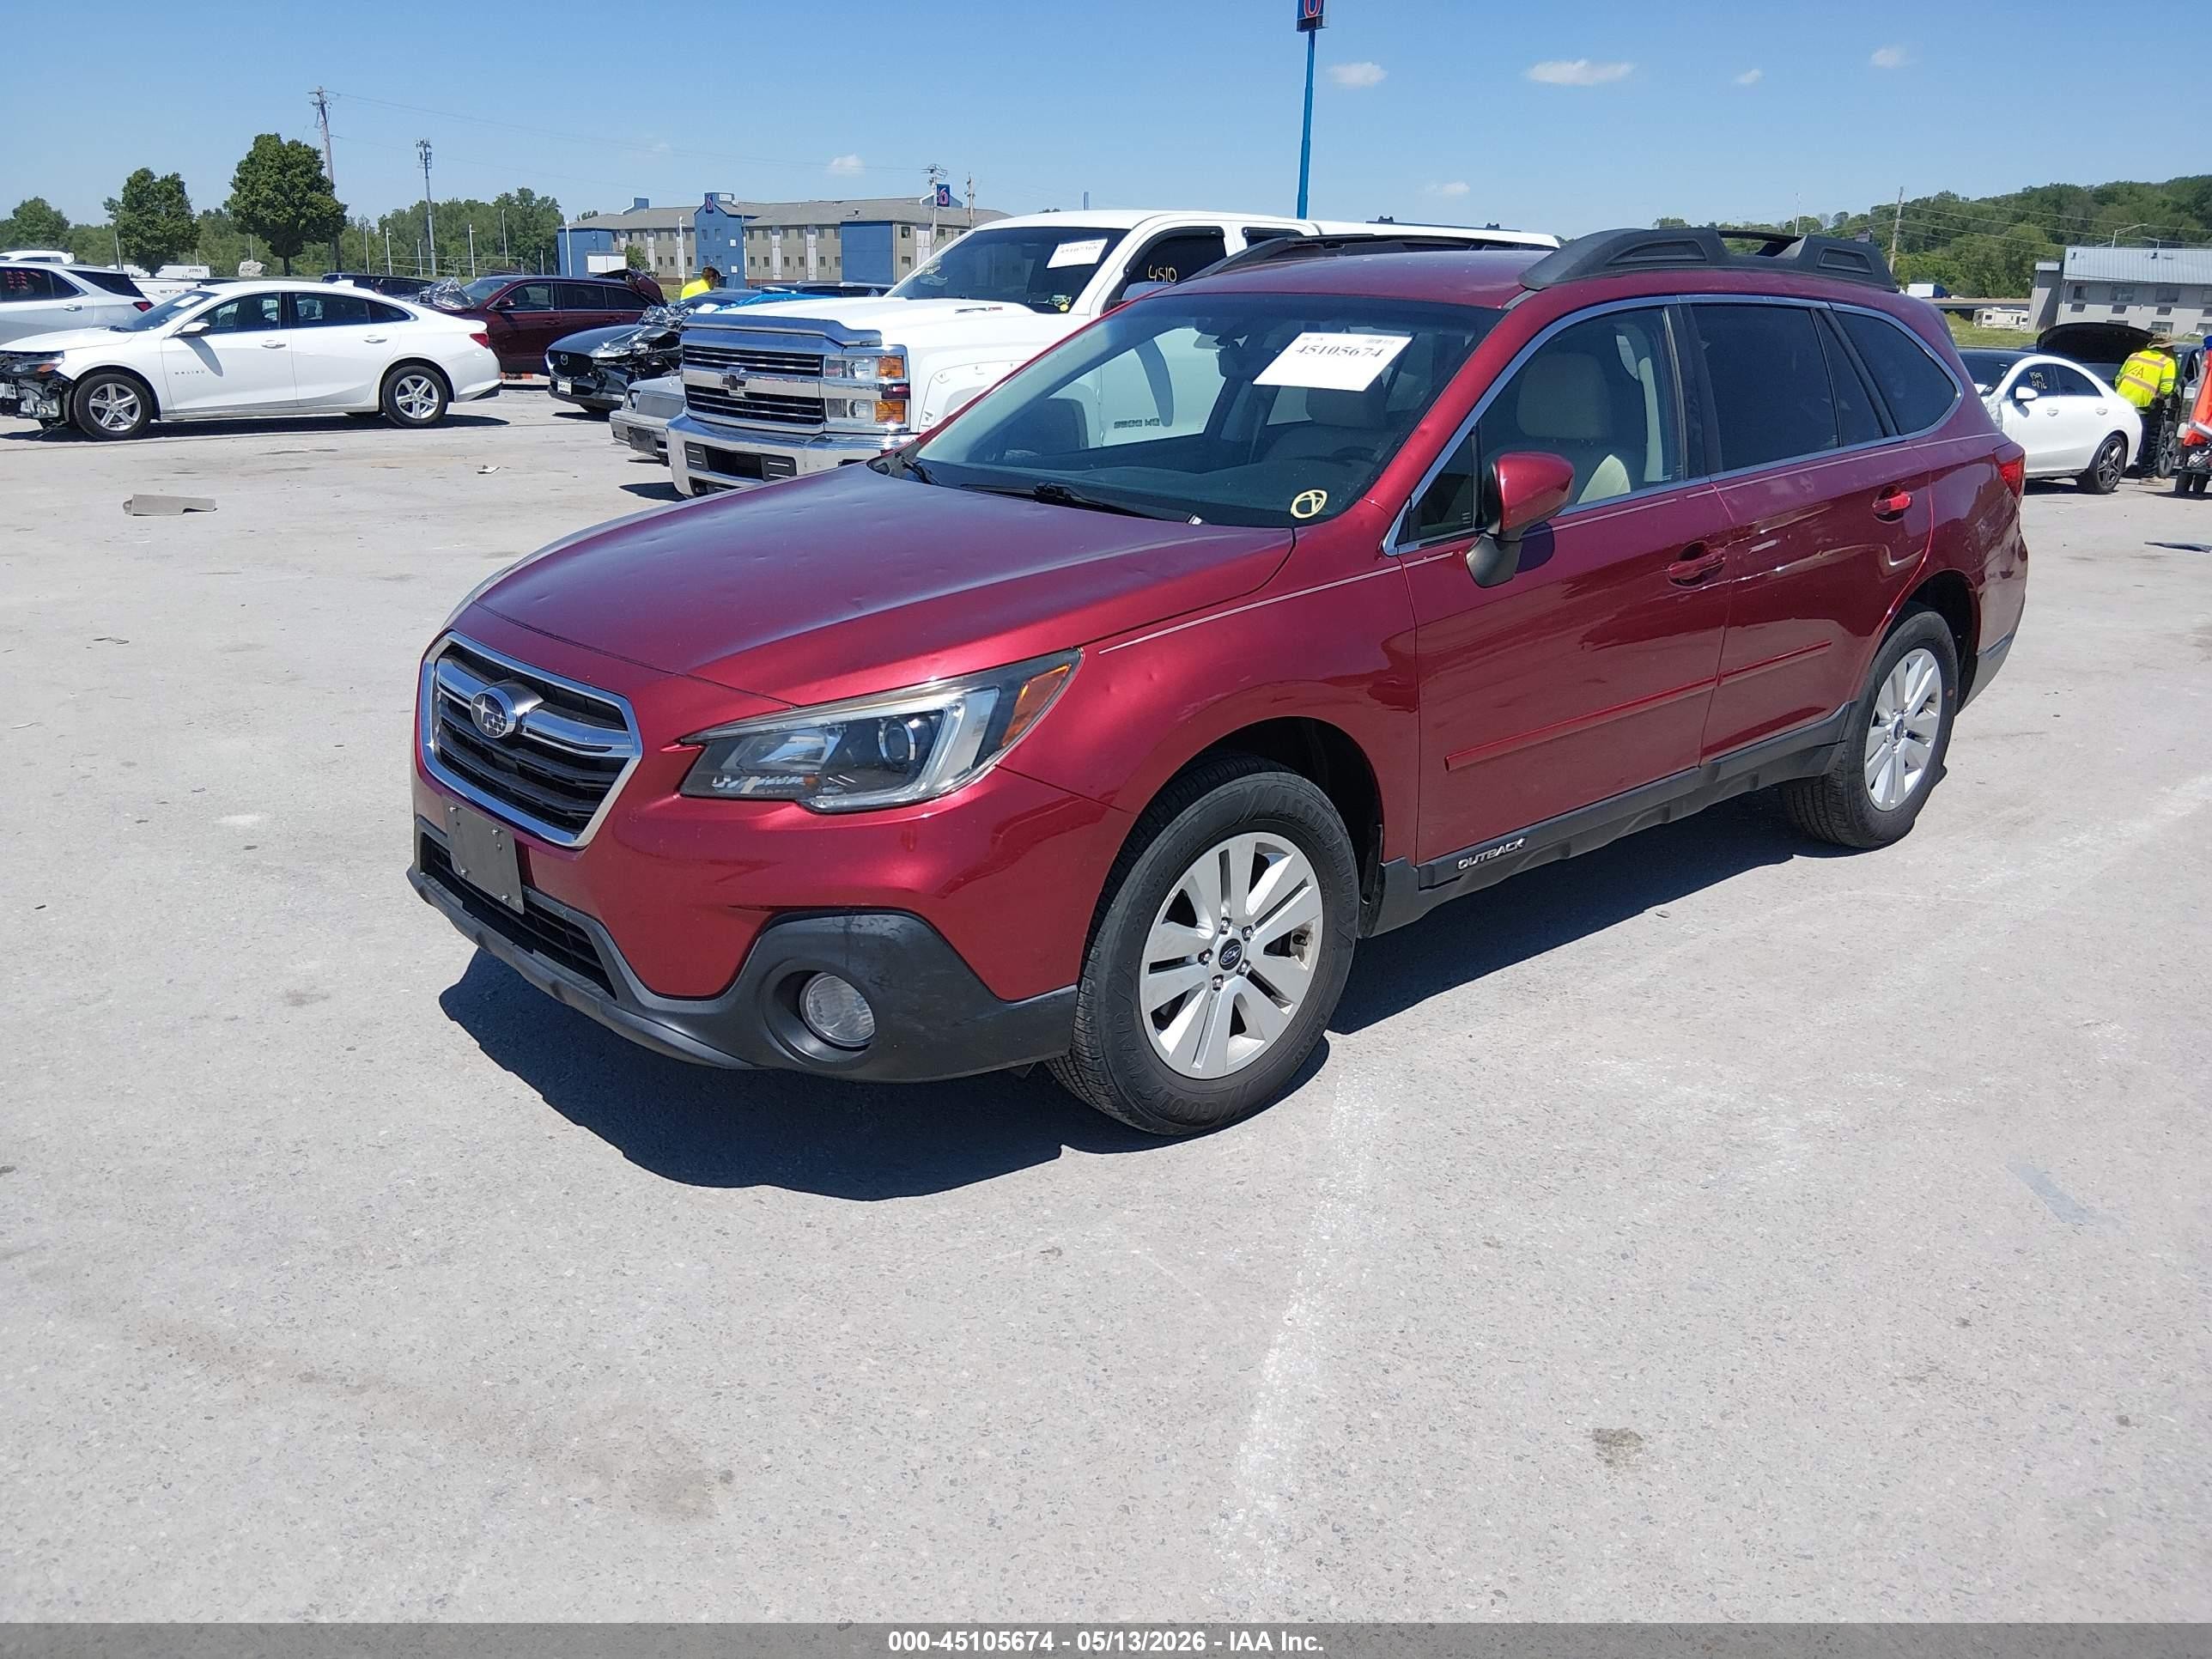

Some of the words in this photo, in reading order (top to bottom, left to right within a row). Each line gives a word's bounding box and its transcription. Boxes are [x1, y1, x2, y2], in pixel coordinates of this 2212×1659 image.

[1148, 264, 1177, 283] 4510
[1296, 345, 1384, 357] 45105674
[1457, 837, 1526, 870] OUTBACK
